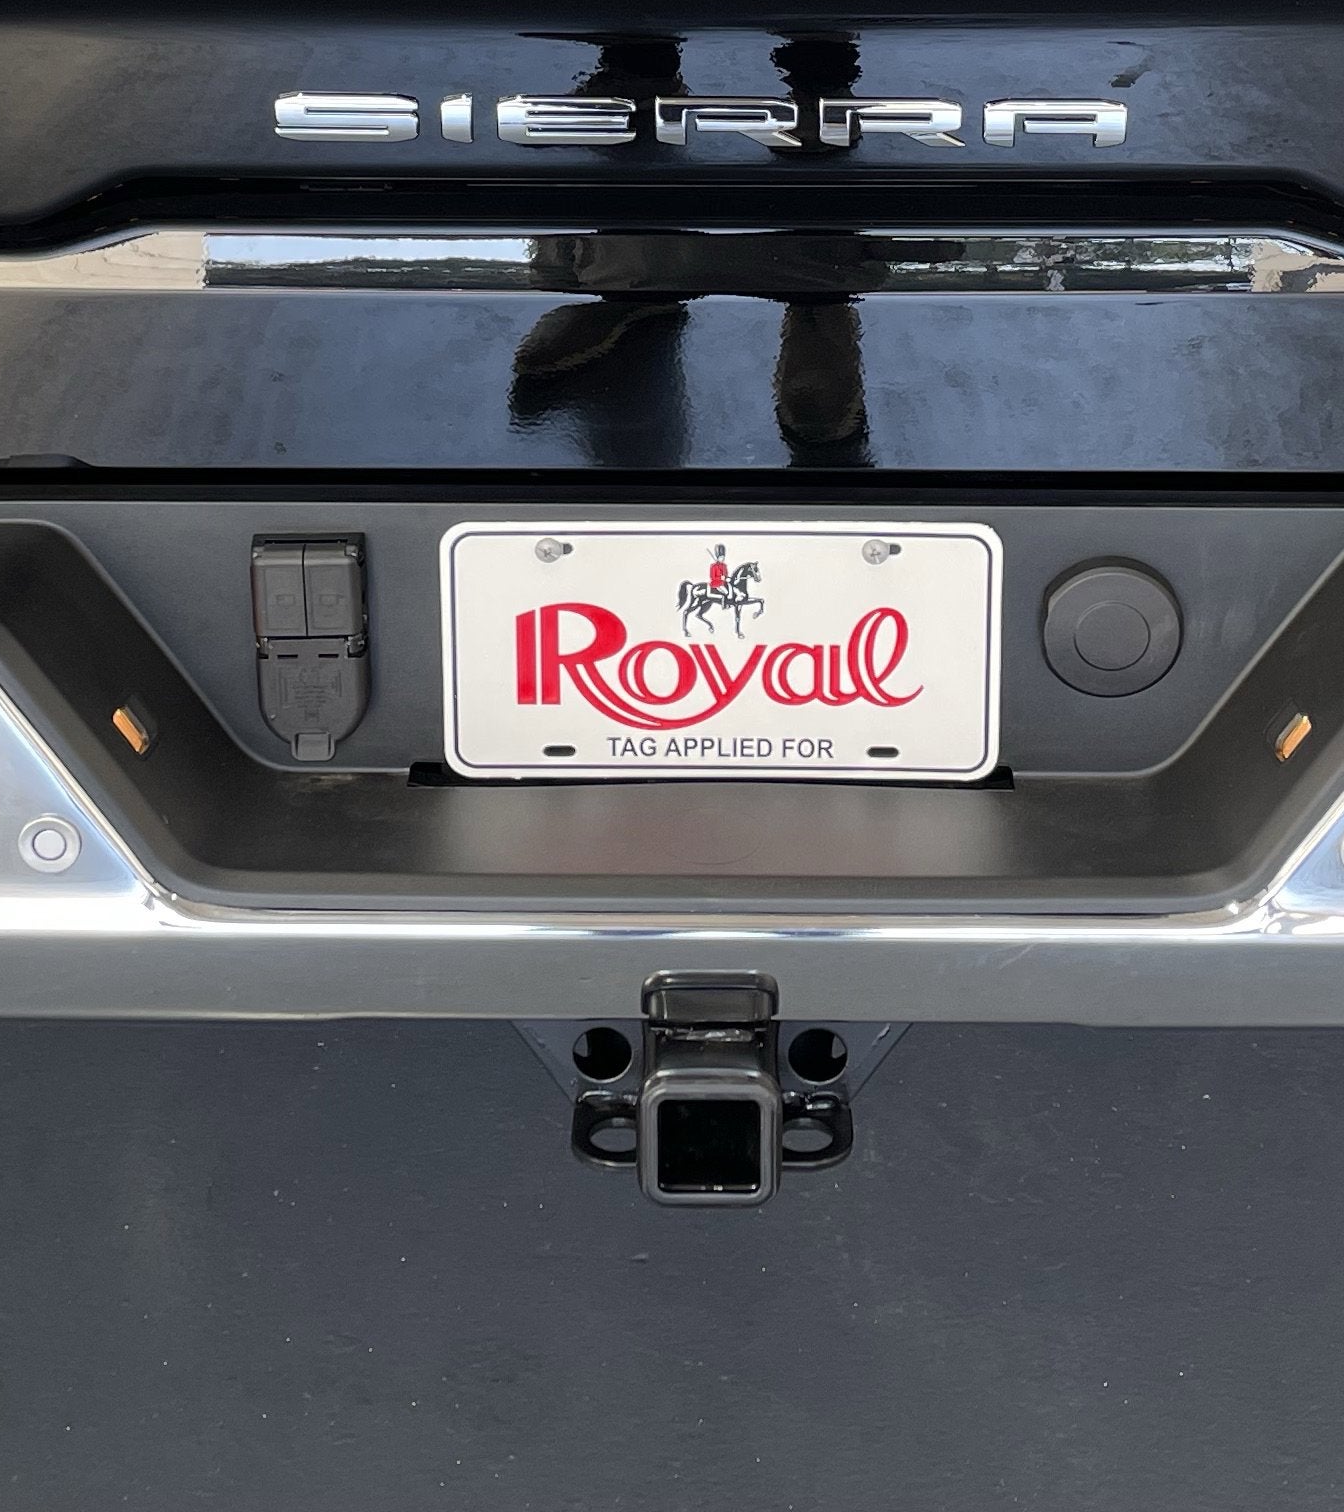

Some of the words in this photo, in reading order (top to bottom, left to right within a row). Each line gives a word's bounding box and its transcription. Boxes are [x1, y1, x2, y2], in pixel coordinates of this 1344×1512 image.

[273, 91, 1129, 148] SIERRA
[516, 602, 924, 730] Royal
[607, 737, 658, 757] TAG
[664, 737, 773, 758] APPLIED
[782, 738, 834, 758] FOR
